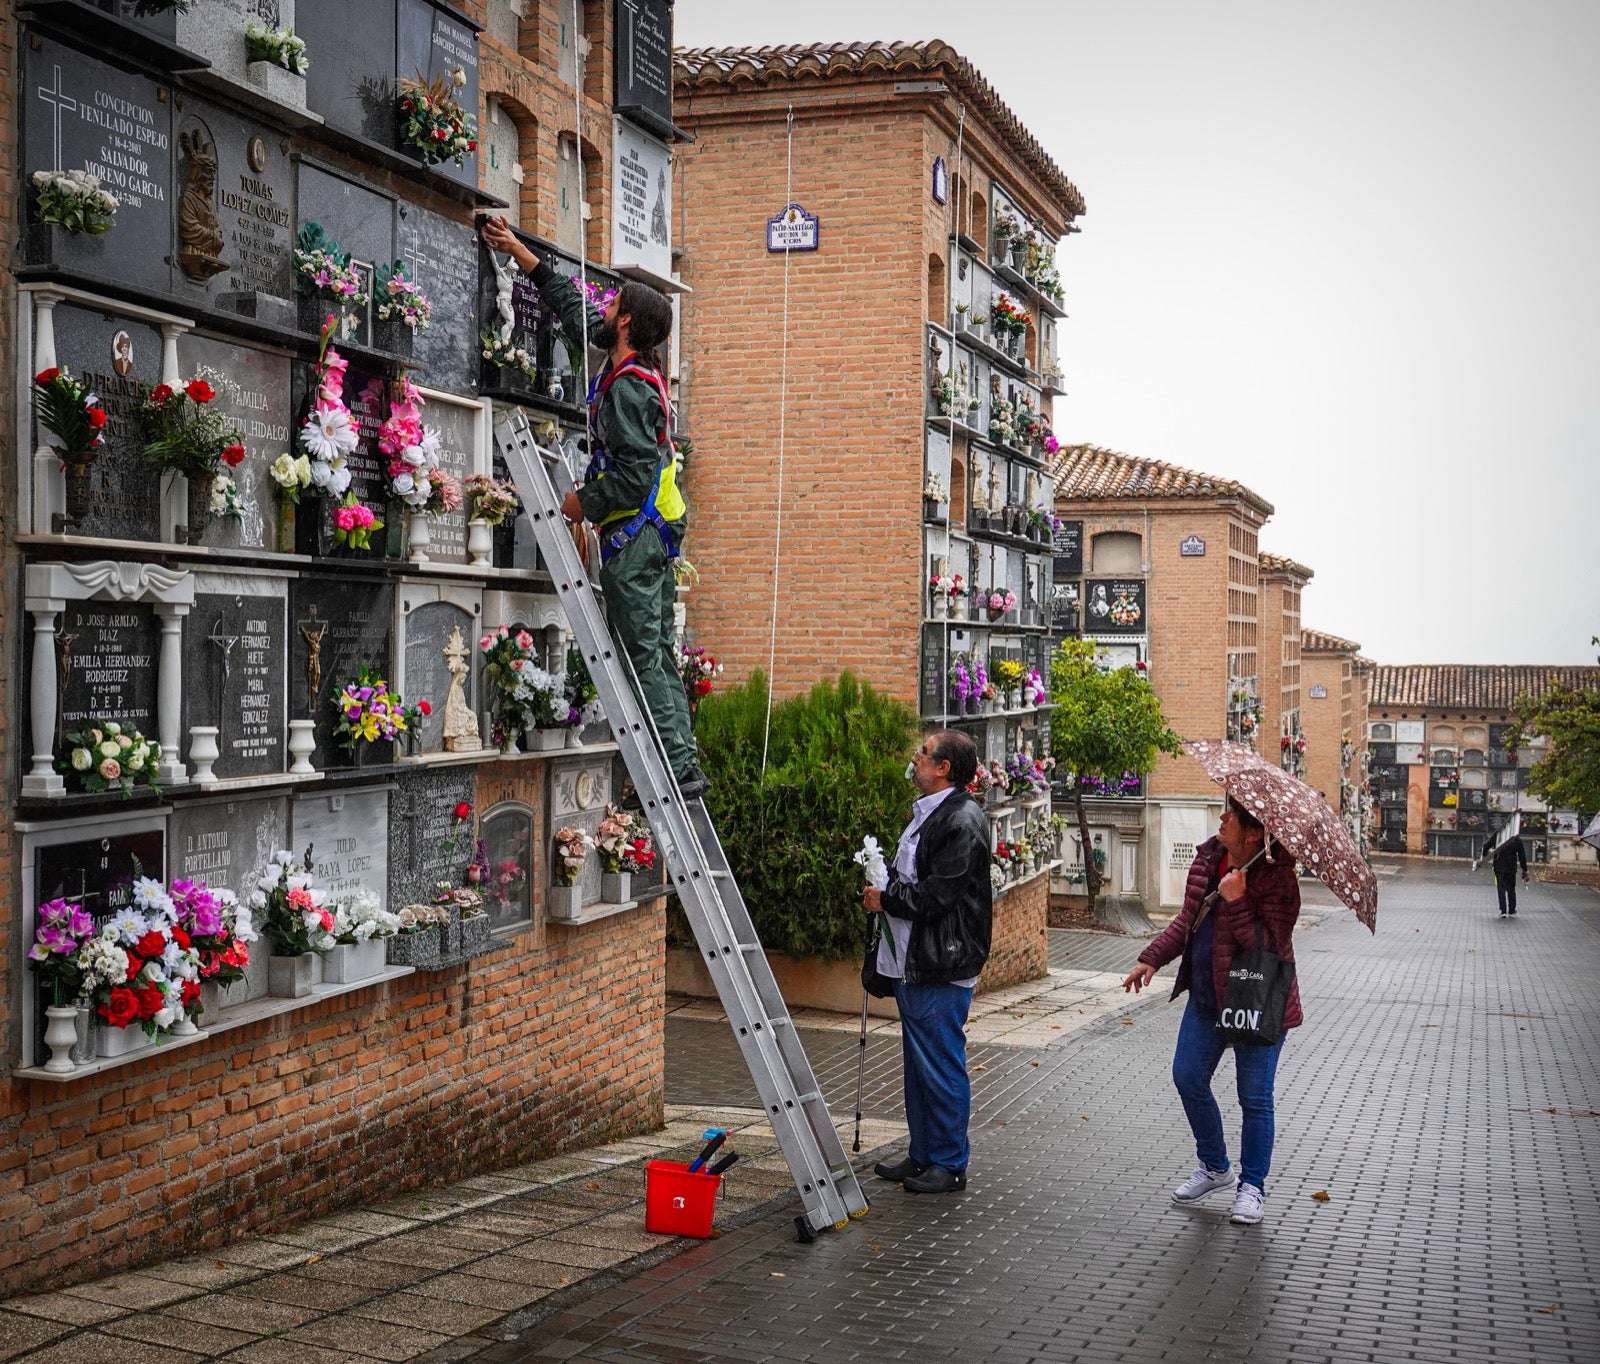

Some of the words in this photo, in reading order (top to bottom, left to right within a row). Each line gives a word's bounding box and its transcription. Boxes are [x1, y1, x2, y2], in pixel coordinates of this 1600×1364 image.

[452, 28, 472, 48] MANUEL
[94, 90, 154, 126] CONCEPCION
[80, 103, 134, 136] TENLLADO
[136, 126, 168, 150] ESPEJO
[101, 146, 149, 178] SALVADOR
[85, 160, 126, 188] MORENO
[128, 176, 164, 201] GARCIA
[240, 174, 273, 201] TOMAS
[222, 190, 252, 215] LOPEZ
[256, 203, 290, 229] GOMEZ
[231, 391, 269, 412] FAMILIA
[350, 400, 371, 414] MANUEL
[251, 421, 289, 442] HIDALGO
[452, 451, 466, 466] LOPEZ
[452, 514, 466, 528] LOPEZ
[86, 614, 106, 627] JOSE
[108, 615, 138, 628] ARMIJO
[99, 629, 118, 642] DIAZ
[242, 636, 270, 649] FERNANDEZ
[74, 655, 102, 668] EMILIA
[105, 655, 151, 668] HERNANDEZ
[248, 652, 264, 664] HUETE
[86, 670, 128, 684] RODRIGUEZ
[248, 679, 264, 692] MARIA
[240, 694, 270, 708] HERNANDEZ
[62, 711, 88, 720] VUESTRA
[89, 710, 112, 719] FAMILIA
[114, 710, 121, 718] NO
[122, 710, 128, 718] OS
[129, 708, 148, 718] OLVIDA
[242, 710, 268, 724] GONZALEZ
[188, 836, 194, 852] D.
[198, 832, 228, 852] ANTONIO
[334, 838, 356, 854] JULIO
[100, 856, 108, 870] 49
[184, 850, 231, 873] PORTELLANO
[318, 861, 341, 879] RAYA
[348, 856, 372, 874] LOPEZ
